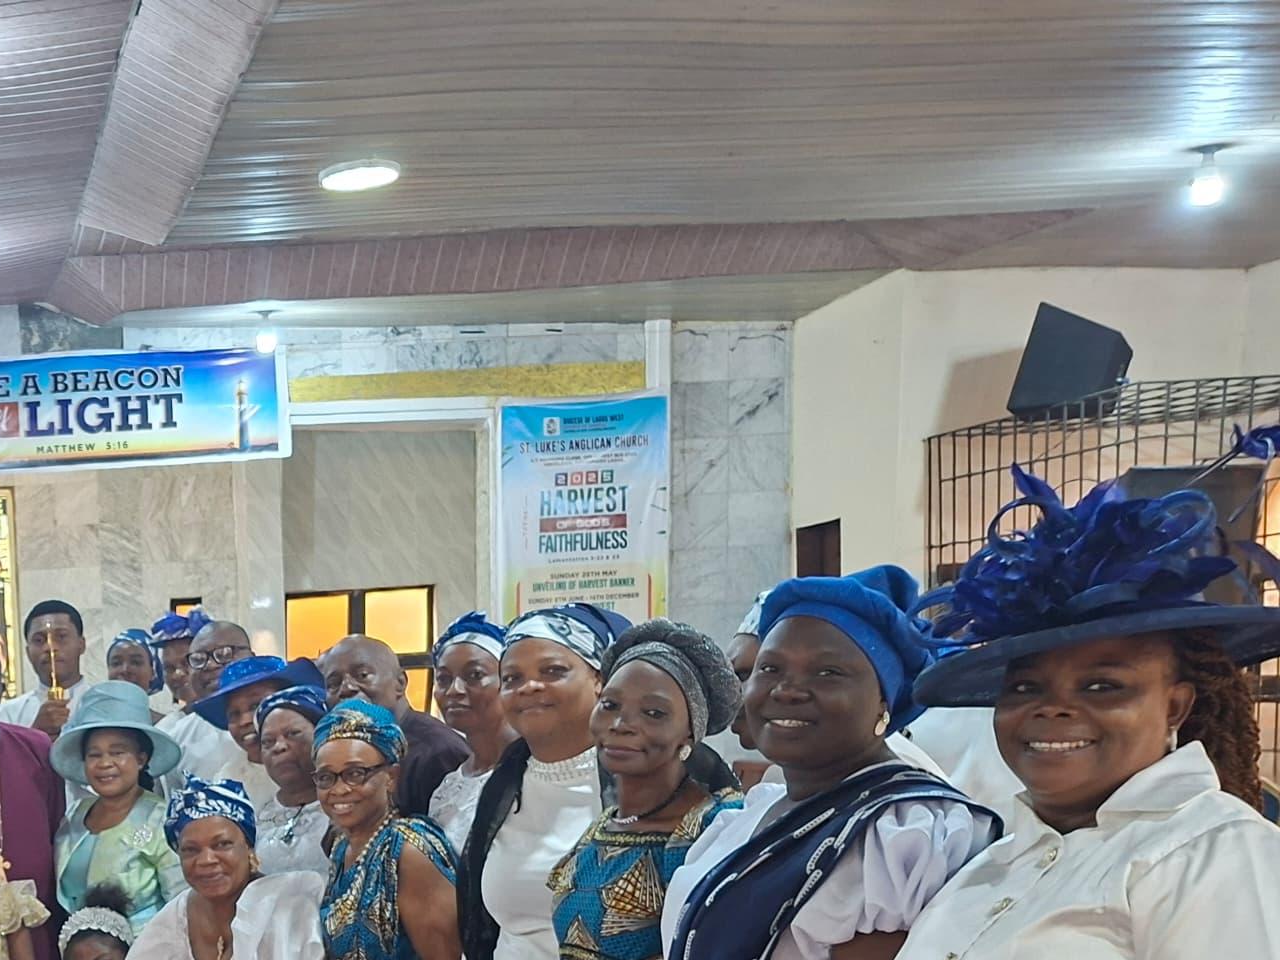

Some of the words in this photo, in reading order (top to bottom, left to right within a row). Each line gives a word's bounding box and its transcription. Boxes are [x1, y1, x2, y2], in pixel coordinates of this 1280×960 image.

[20, 374, 42, 396] A
[51, 366, 183, 393] BEACON
[24, 393, 183, 437] LIGHT
[36, 443, 96, 454] MATTHEW
[106, 440, 129, 451] 5:16
[535, 440, 566, 453] LUKE'S
[568, 437, 612, 451] ANGLICAN
[614, 434, 649, 448] CHURCH
[555, 470, 614, 486] 2025
[540, 485, 628, 516] HARVEST
[539, 530, 628, 554] FAITHFULNESS
[550, 572, 580, 580] SUNDAY
[578, 578, 608, 588] HARVEST
